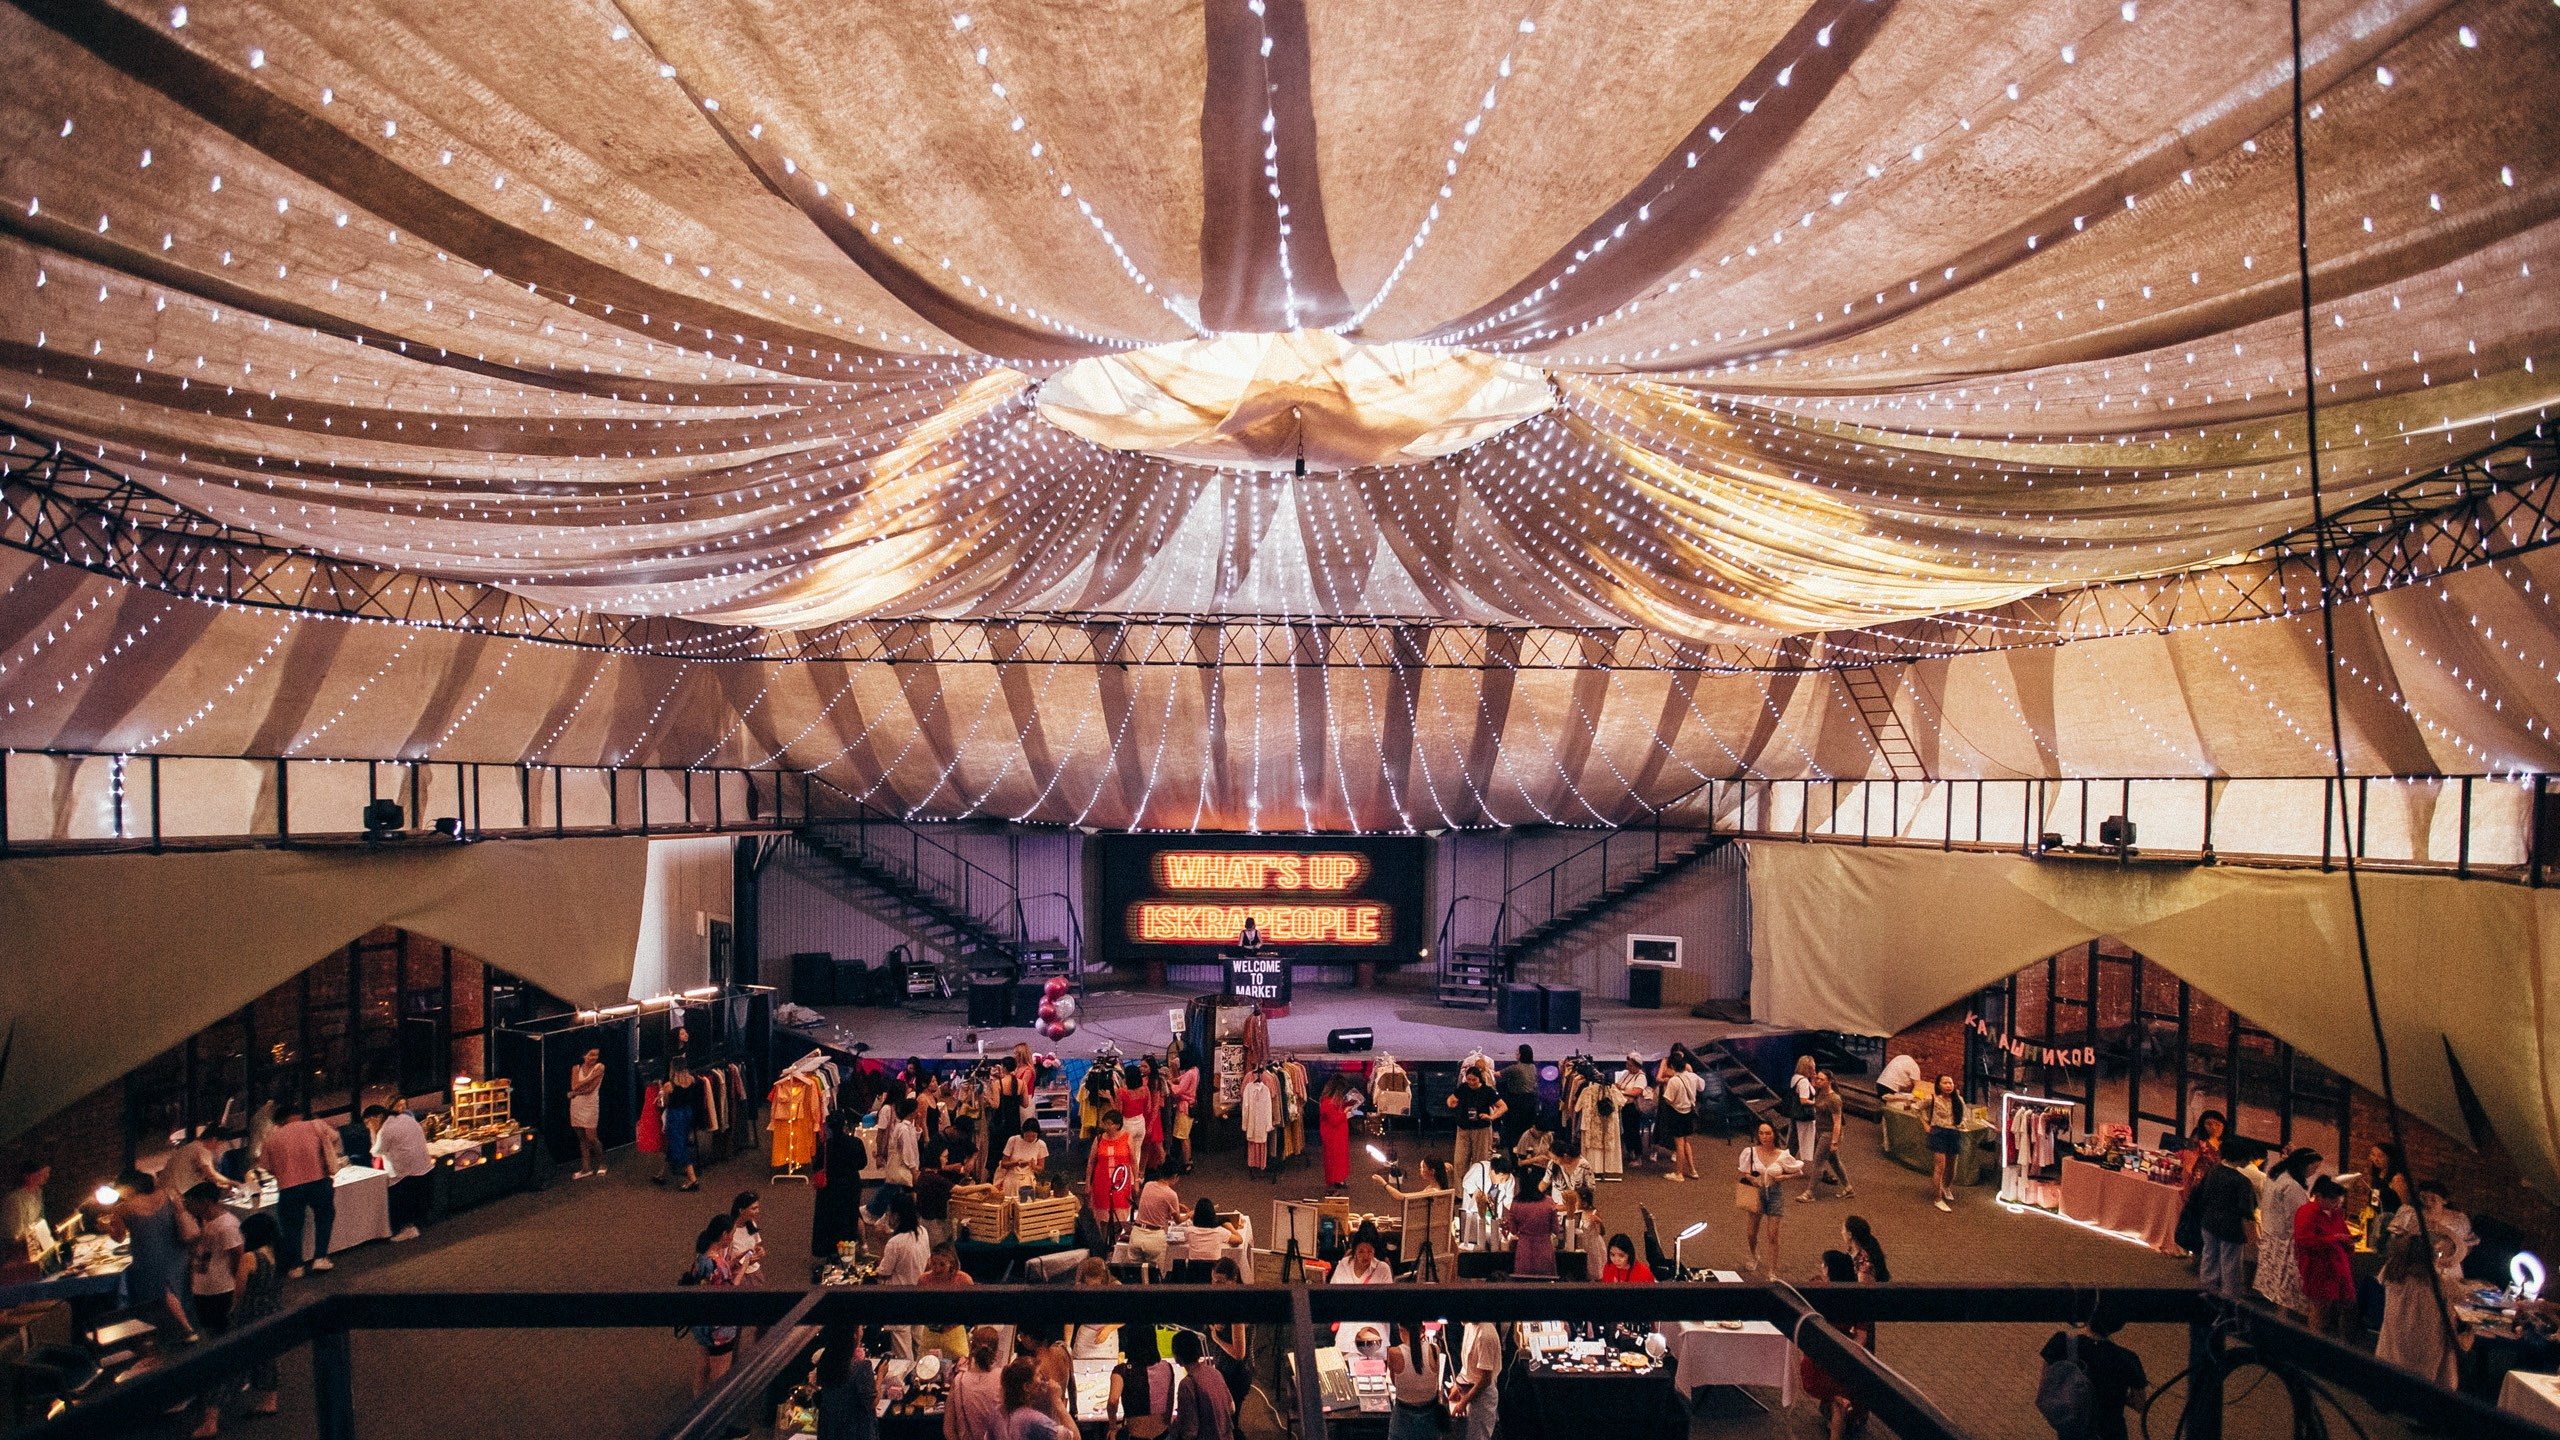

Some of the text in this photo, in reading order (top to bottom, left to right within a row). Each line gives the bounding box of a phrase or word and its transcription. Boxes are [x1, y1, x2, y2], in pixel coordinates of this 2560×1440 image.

[1166, 854, 1357, 890] WHAT'S UP
[1142, 905, 1380, 940] ISKRAPEOPLE
[1232, 960, 1281, 973] WELCOME
[1250, 972, 1264, 985] TO
[1235, 985, 1278, 998] MARKET
